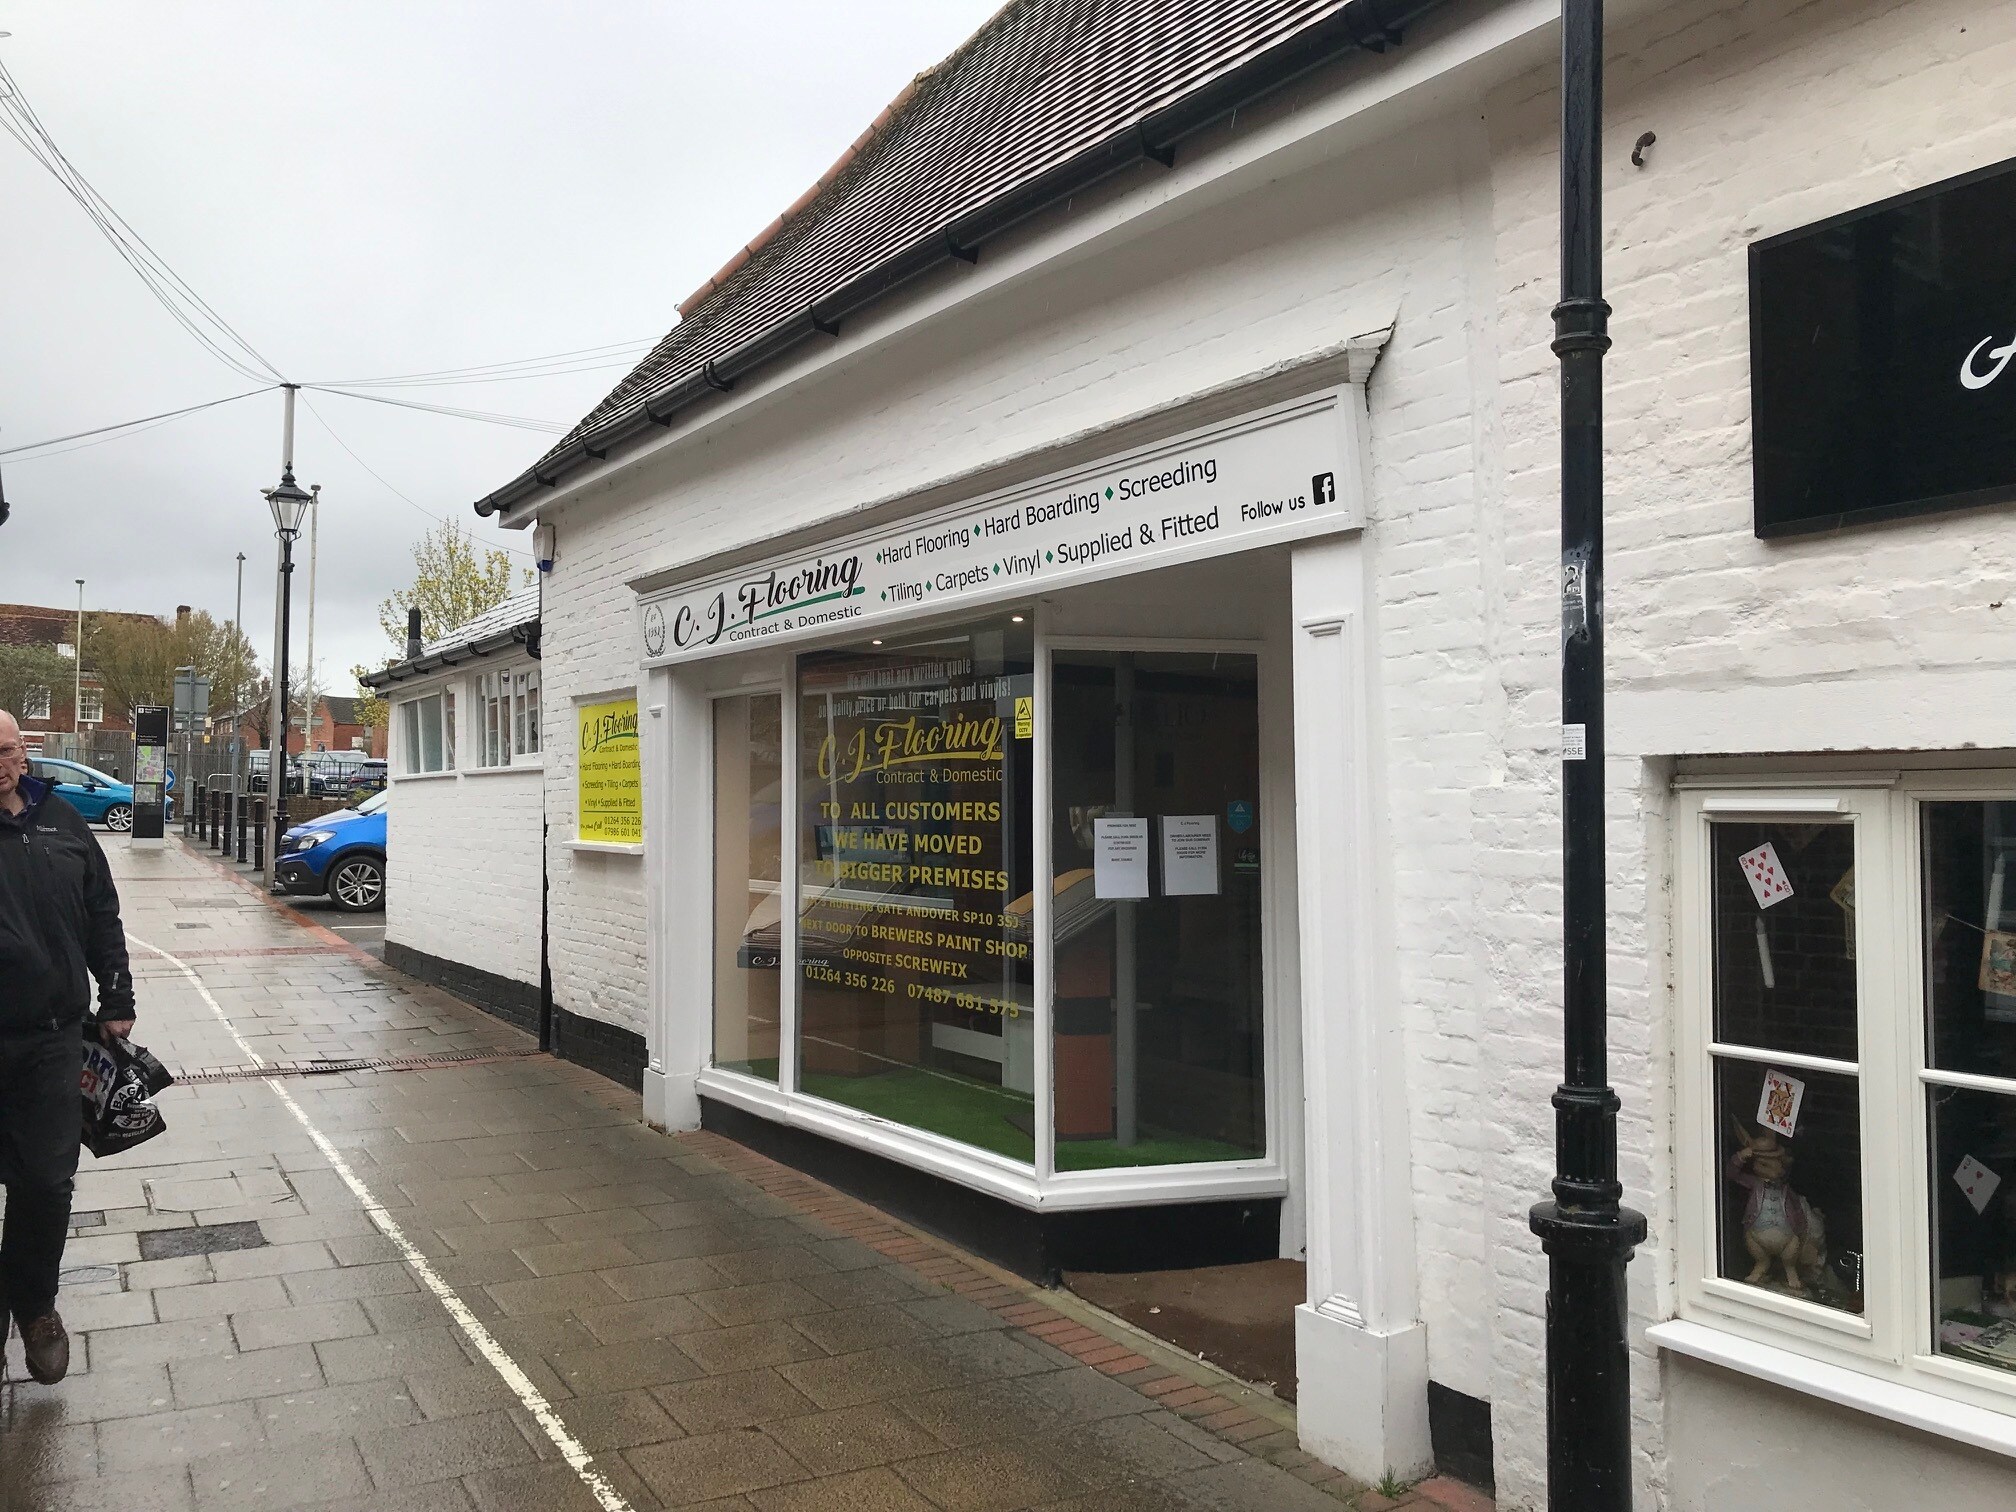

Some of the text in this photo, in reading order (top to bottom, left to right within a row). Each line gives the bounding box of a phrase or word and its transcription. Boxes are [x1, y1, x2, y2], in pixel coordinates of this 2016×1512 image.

[882, 457, 1218, 565] Hard Flooring Hard Boarding Screeding
[1241, 495, 1306, 523] Follow us
[888, 505, 1219, 603] Tiling Carpets Vinyl Supplied & Fitted
[738, 555, 863, 624] Flooring
[729, 604, 863, 642] Contract & Domestic
[861, 671, 875, 689] will
[878, 669, 894, 687] beat
[897, 668, 911, 686] any
[913, 662, 944, 683] written
[947, 658, 971, 680] quote
[889, 692, 906, 710] both
[909, 690, 922, 708] for
[925, 686, 958, 708] carpets
[961, 681, 977, 702] and
[980, 677, 1011, 700] vinyls!
[620, 743, 638, 752] Domestic
[874, 712, 1004, 770] Flooring
[1567, 747, 1583, 756] SSE
[611, 761, 621, 770] Hard
[622, 759, 641, 771] Boarding
[876, 766, 1003, 785] Contract & Domestic
[584, 779, 639, 791] Screeding Tiling Carpets
[587, 798, 598, 809] Vinyl
[600, 798, 618, 808] Supplied
[623, 798, 636, 807] Fitted
[820, 801, 1001, 822] TO ALL CUSTOMERS
[604, 816, 642, 826] 01264 356 226
[621, 828, 630, 837] 601
[631, 828, 642, 838] 041
[833, 832, 982, 855] WE HAVE MOVED
[815, 860, 1009, 892] TO BIGGER PREMISES
[877, 903, 903, 916] GATE
[906, 906, 959, 922] ANDOVER
[963, 911, 993, 926] SP10
[826, 922, 852, 935] DOOR
[856, 925, 868, 937] TO
[871, 925, 933, 946] BREWERS
[937, 934, 982, 953] PAINT
[985, 940, 1028, 959] SHOP
[842, 948, 968, 979] OPPOSITE SCREWFIX
[805, 965, 841, 983] 01264
[845, 972, 868, 989] 356
[871, 976, 896, 994] 226
[907, 983, 951, 1004] 07487
